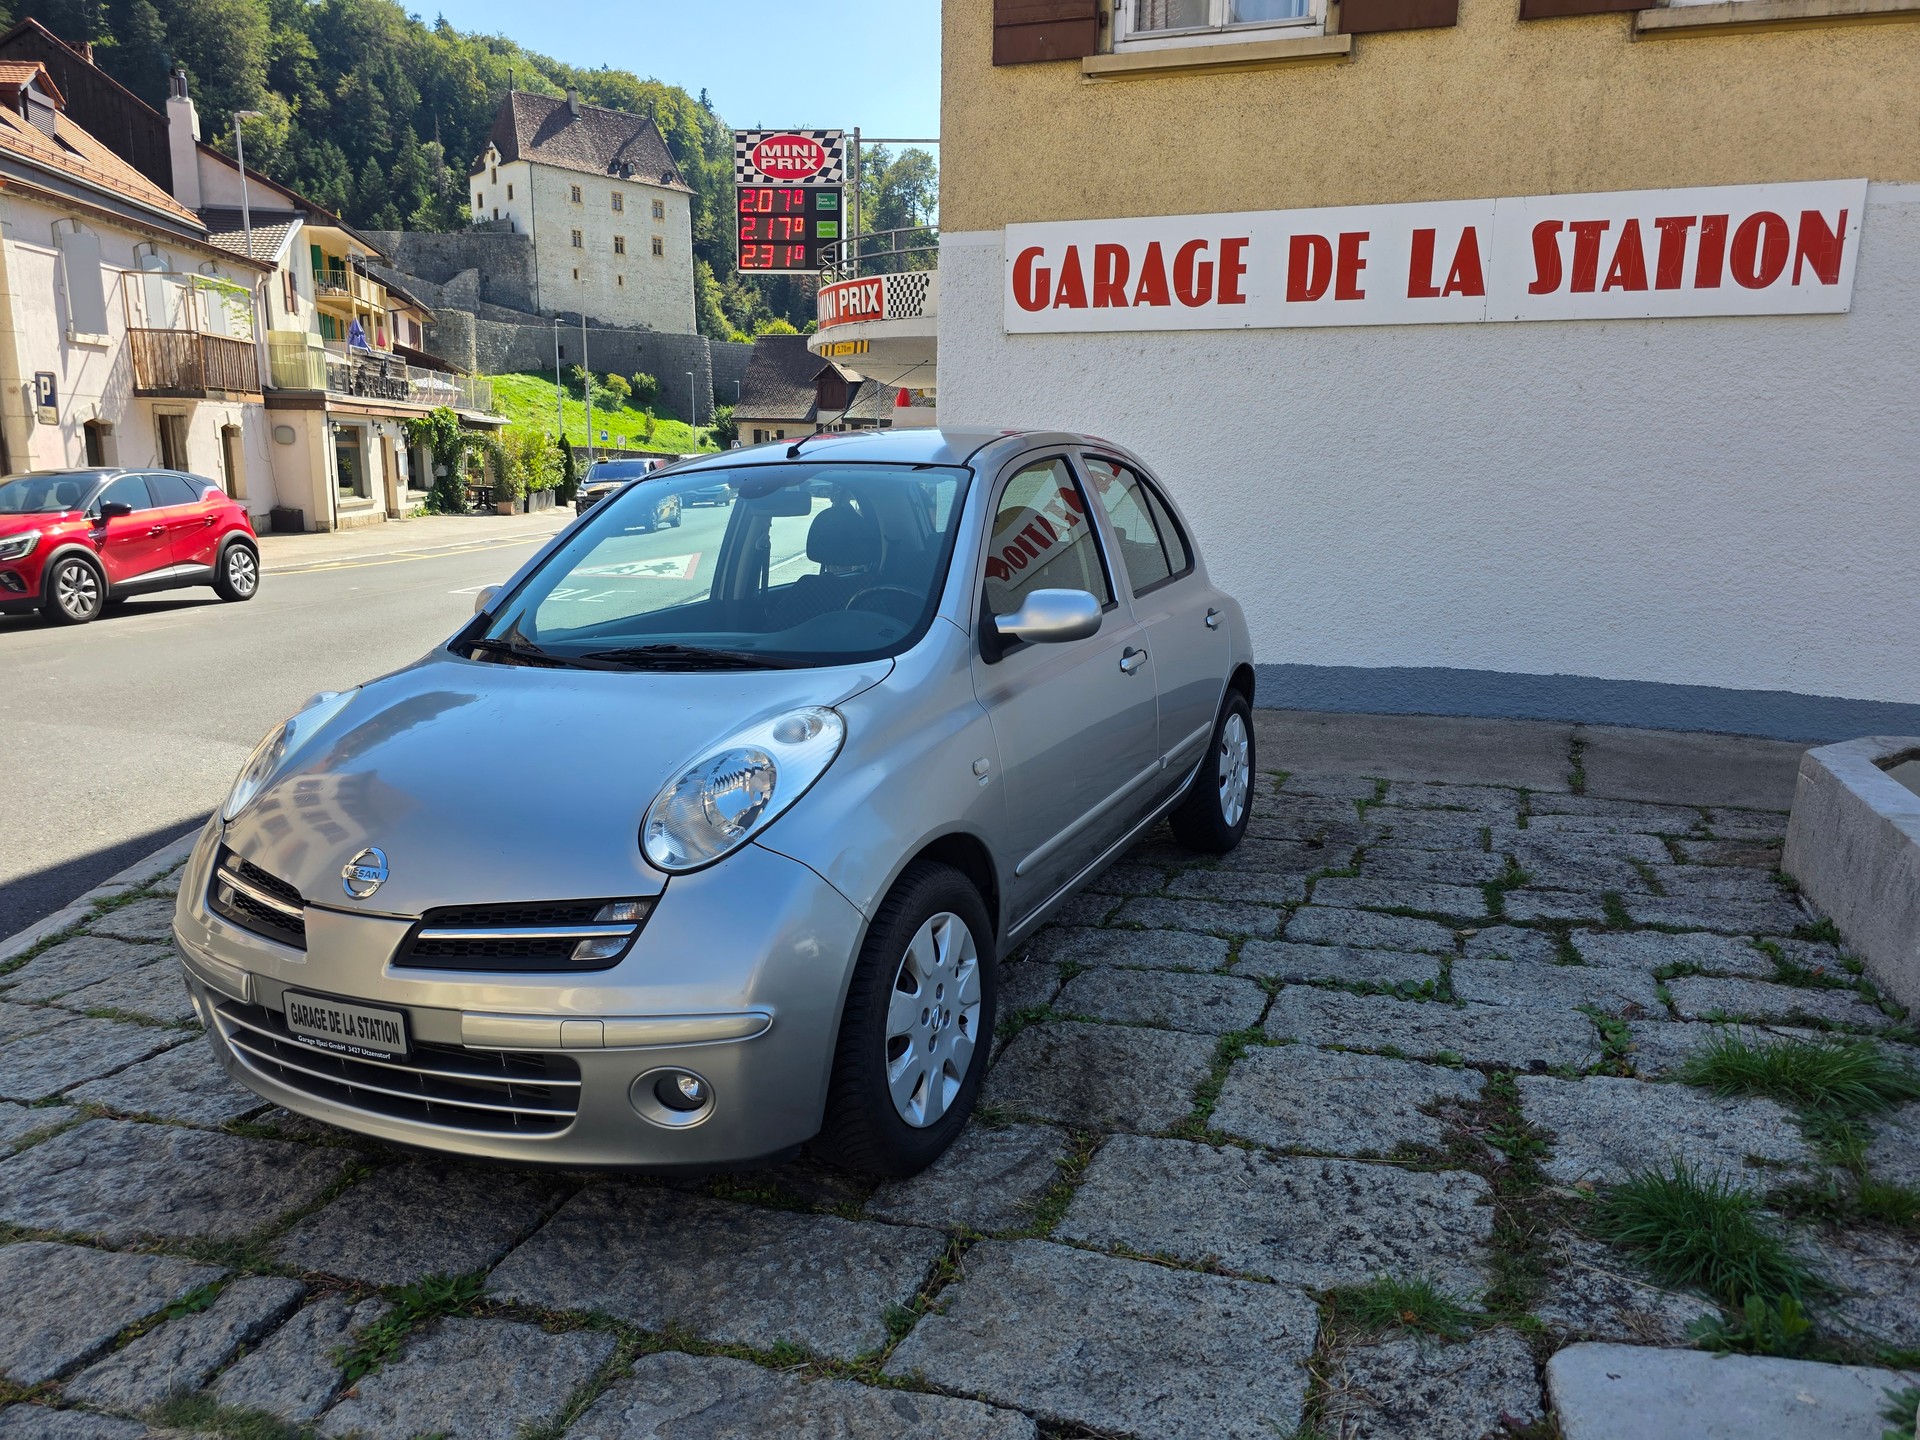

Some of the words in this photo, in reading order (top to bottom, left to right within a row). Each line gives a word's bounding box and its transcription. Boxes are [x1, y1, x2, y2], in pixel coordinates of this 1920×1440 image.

[760, 145, 818, 157] MINI
[760, 158, 818, 170] PRIX
[1012, 237, 1250, 312] GARAGE
[1286, 231, 1370, 303] DE
[1407, 226, 1486, 299] LA
[1528, 208, 1849, 295] STATION
[839, 283, 881, 317] PRIX
[40, 376, 51, 404] P
[346, 866, 380, 879] NISSAN
[290, 1002, 328, 1031] GARAGE
[328, 1010, 342, 1034] DE
[343, 1013, 357, 1037] LA
[358, 1015, 400, 1045] STATION
[298, 1035, 315, 1046] Garage
[328, 1042, 346, 1051] GmbH
